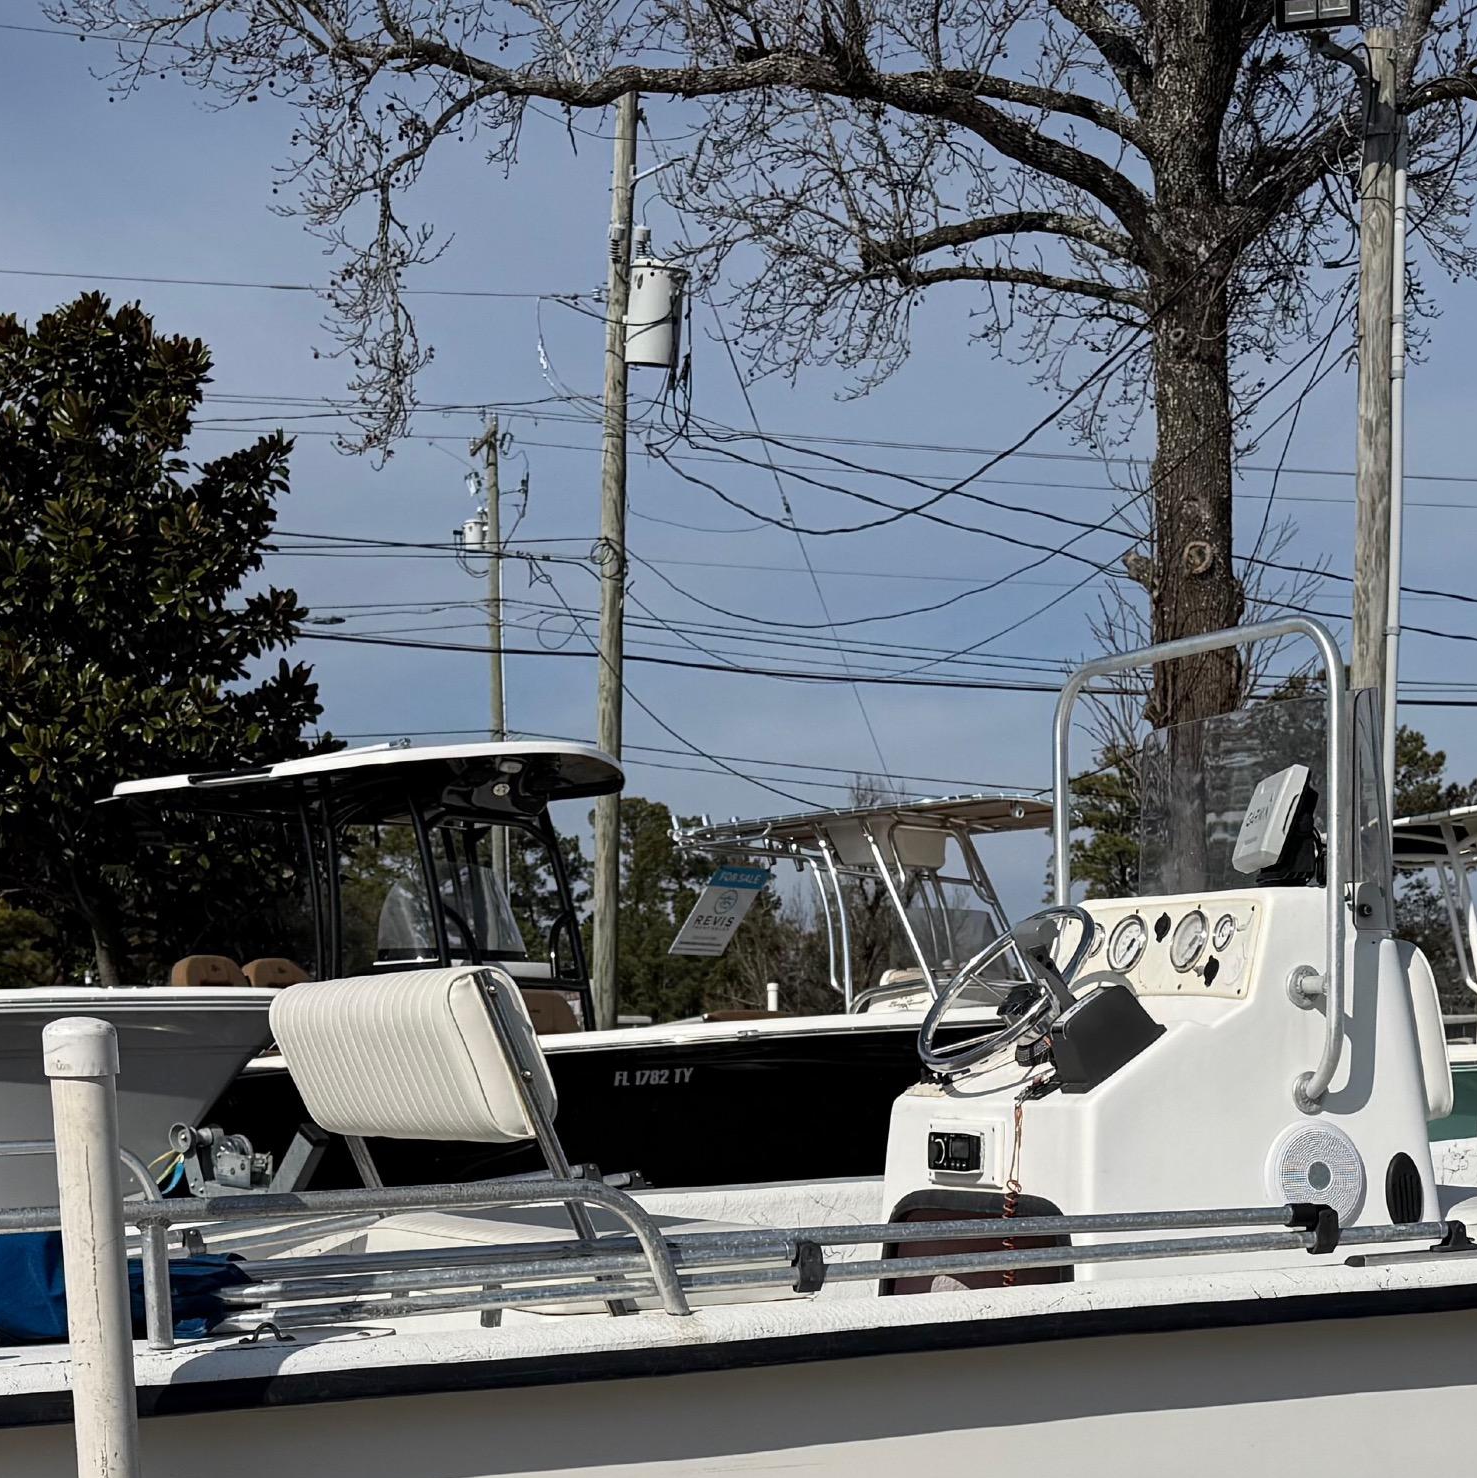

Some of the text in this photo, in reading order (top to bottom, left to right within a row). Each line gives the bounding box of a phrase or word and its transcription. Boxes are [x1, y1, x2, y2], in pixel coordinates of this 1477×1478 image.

[694, 915, 735, 927] REVIS
[613, 1067, 694, 1086] FL 1782 TY
